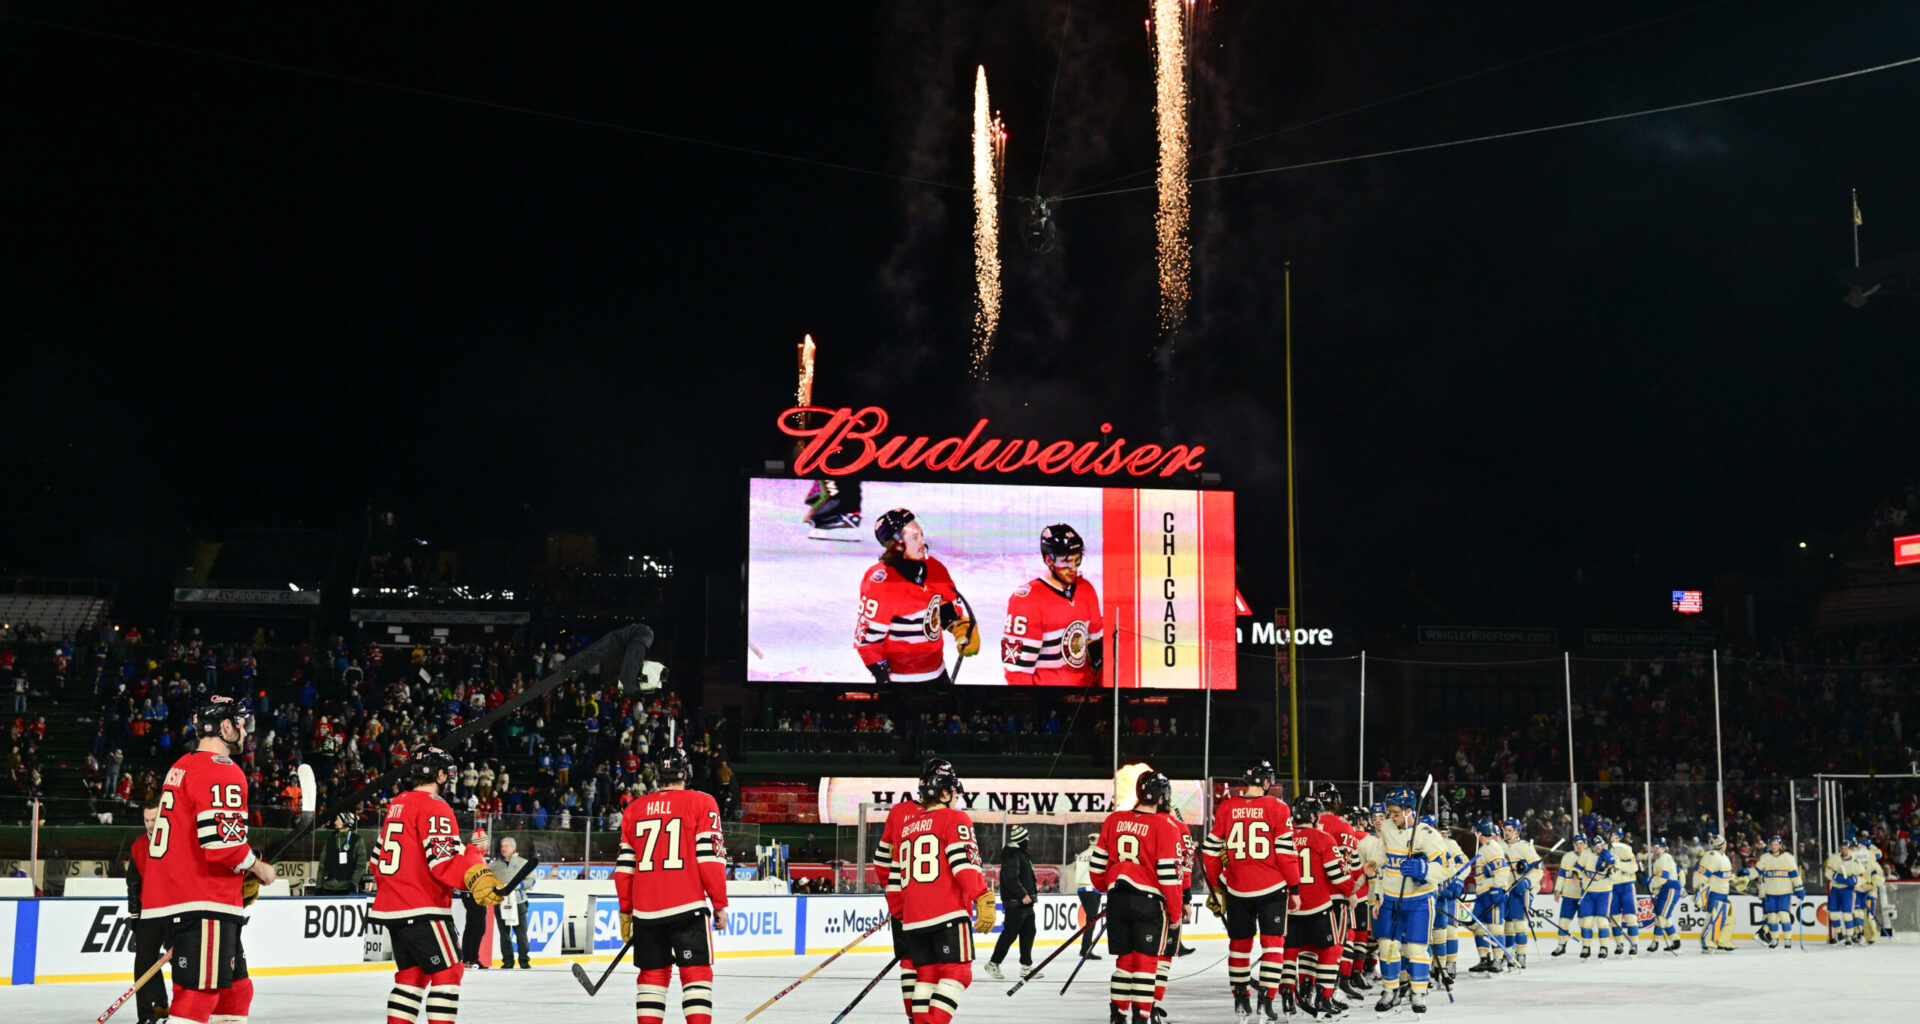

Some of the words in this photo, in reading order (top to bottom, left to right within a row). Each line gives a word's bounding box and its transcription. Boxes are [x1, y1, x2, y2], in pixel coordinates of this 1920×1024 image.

[777, 406, 1206, 477] Budweiser
[1163, 512, 1176, 667] CHICAGO
[1252, 622, 1334, 646] Moore
[1281, 713, 1289, 756] 353
[211, 784, 242, 808] 16
[872, 791, 980, 811] HAY
[986, 792, 1059, 813] NEW
[646, 801, 672, 815] HALL
[1232, 808, 1263, 819] CREVIER
[428, 816, 451, 834] 15
[901, 819, 933, 837] BEDARD
[1116, 821, 1149, 837] DONATO
[635, 817, 685, 872] 71
[1117, 834, 1140, 865] 8
[1227, 821, 1270, 860] 46
[276, 862, 304, 877] aws
[899, 833, 940, 889] 98
[559, 869, 579, 880] SAP
[590, 869, 609, 880] SAP
